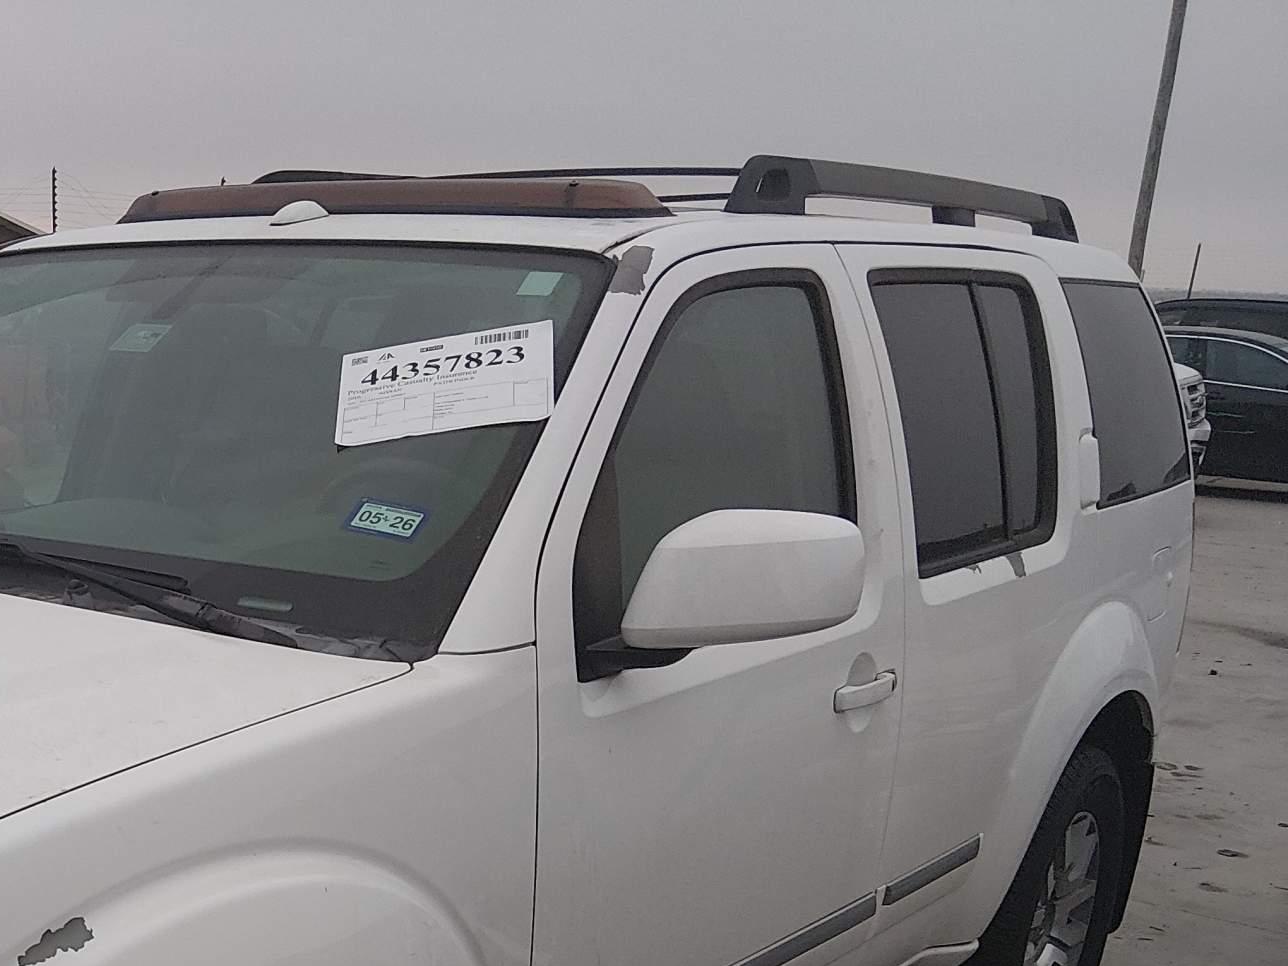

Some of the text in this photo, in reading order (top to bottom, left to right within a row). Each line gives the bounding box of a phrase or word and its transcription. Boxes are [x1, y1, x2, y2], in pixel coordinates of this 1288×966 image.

[361, 346, 525, 386] 44357823
[358, 510, 385, 524] 05
[389, 516, 416, 531] 26
